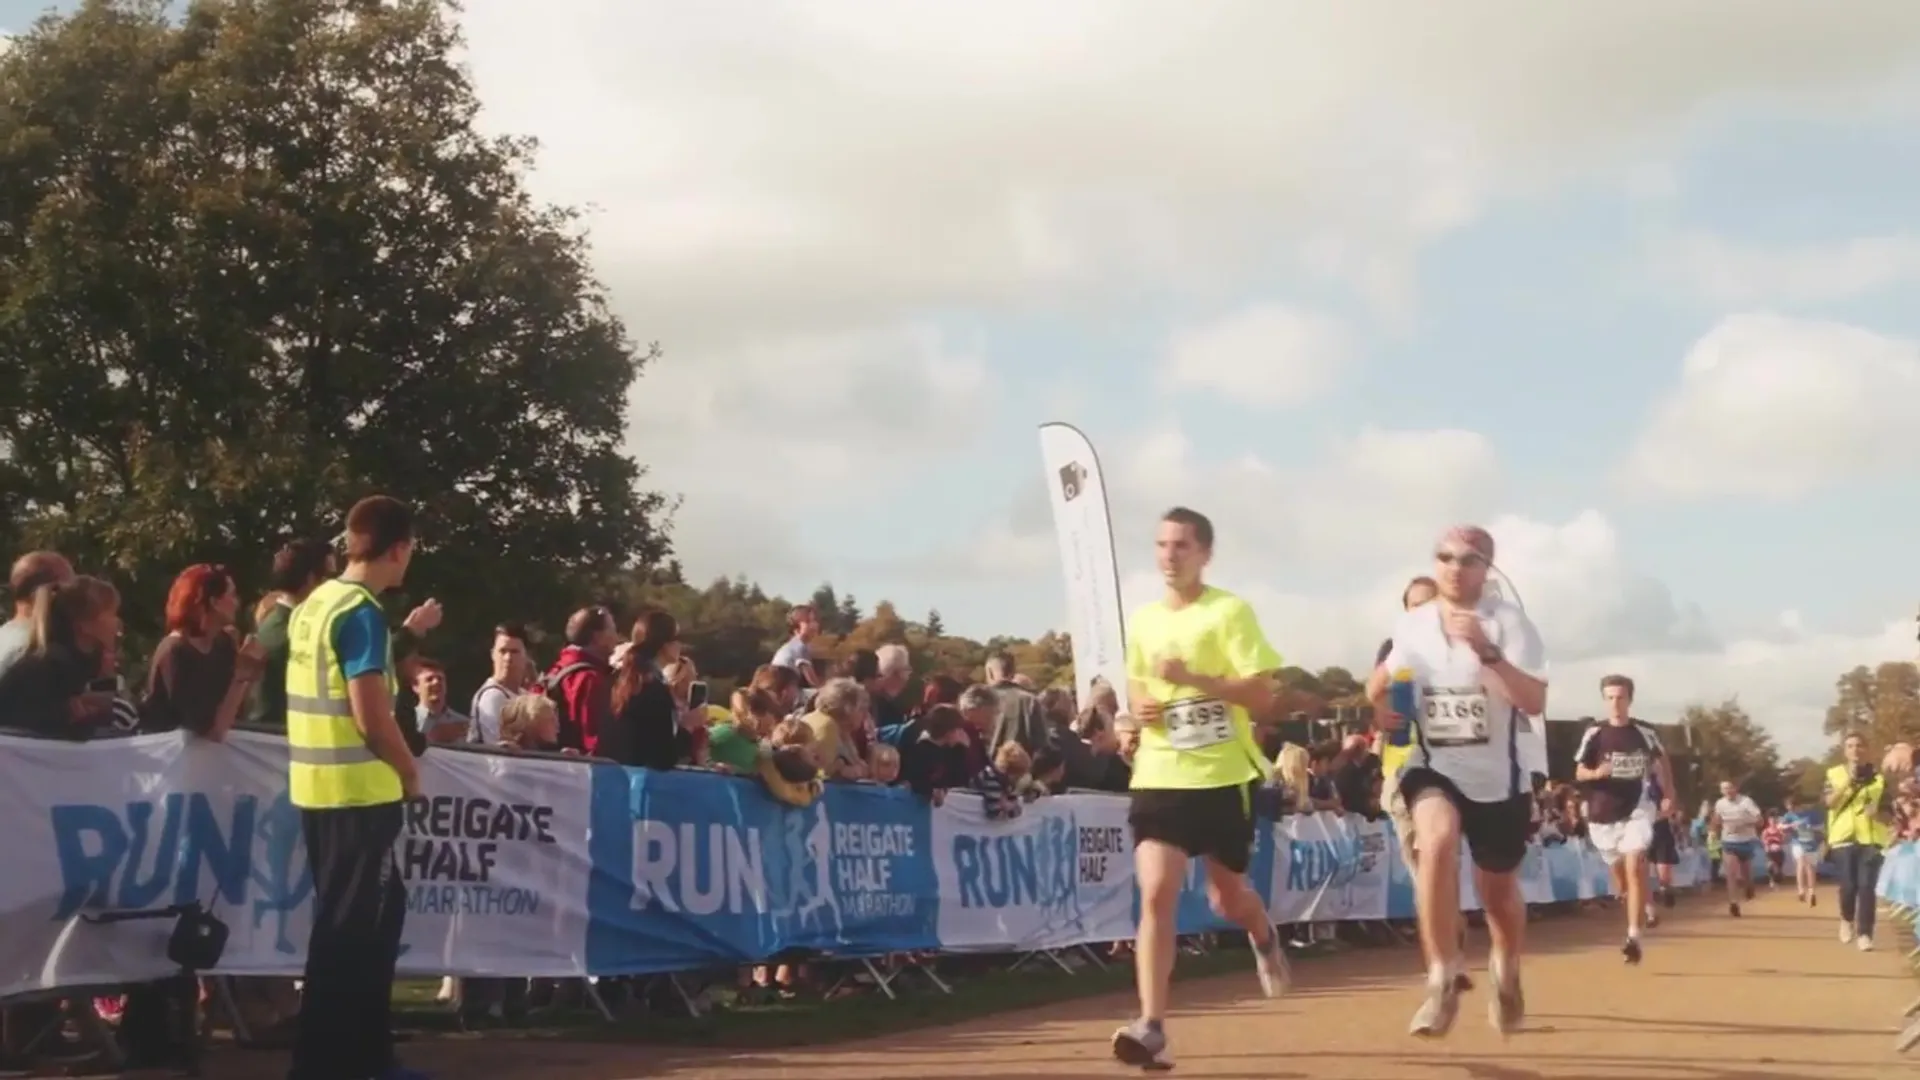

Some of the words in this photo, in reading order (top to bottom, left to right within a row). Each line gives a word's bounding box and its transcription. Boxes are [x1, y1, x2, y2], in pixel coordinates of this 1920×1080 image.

[406, 794, 556, 843] REIGATE
[50, 792, 258, 921] RUN
[834, 821, 915, 857] REIGATE
[1079, 826, 1123, 853] REIGATE
[403, 839, 498, 882] HALF
[629, 820, 768, 915] RUN
[837, 857, 892, 892] HALF
[953, 834, 1037, 908] RUN
[1079, 856, 1107, 883] HALF
[405, 885, 539, 915] MARATHON
